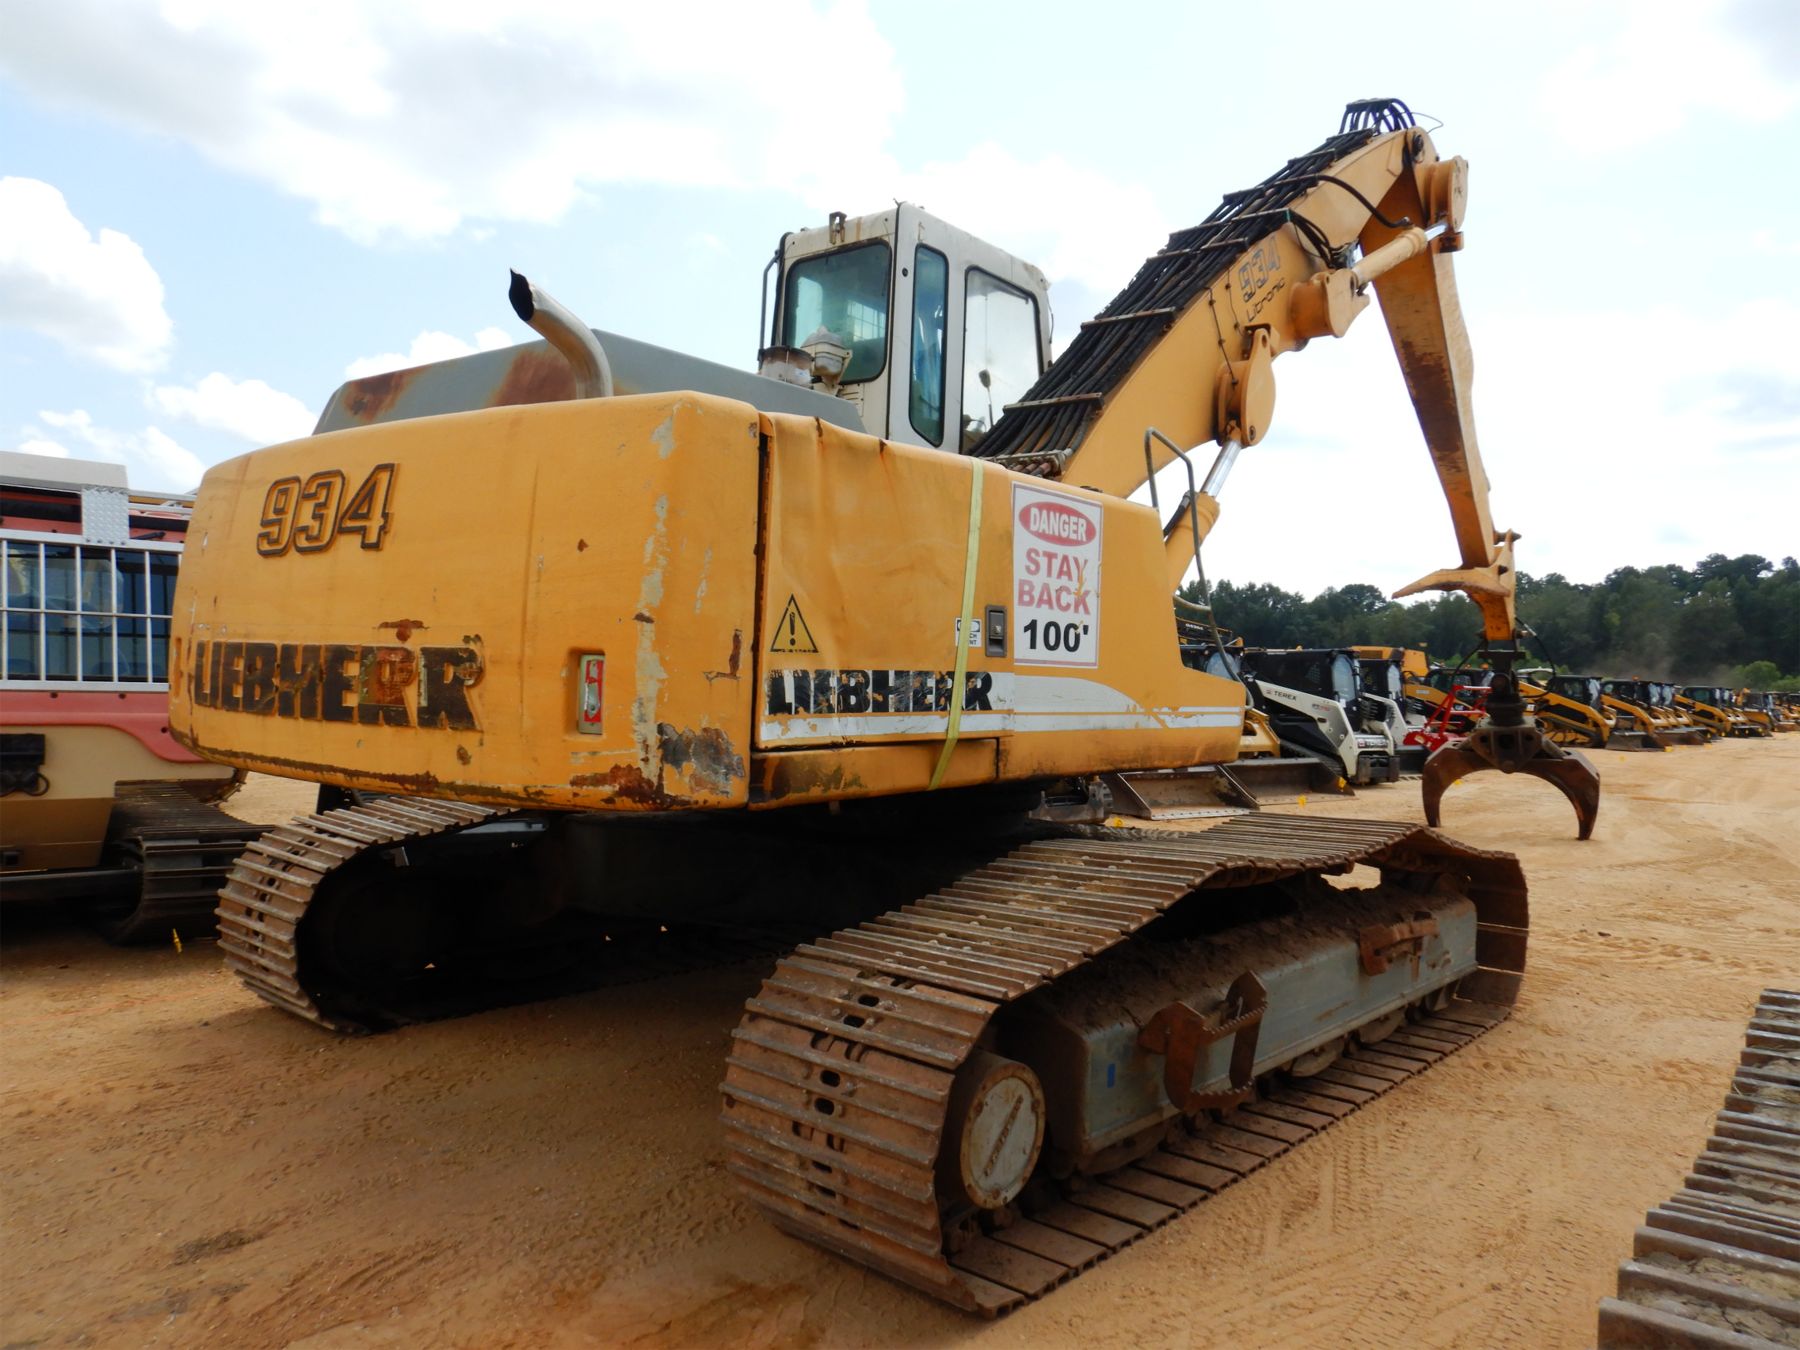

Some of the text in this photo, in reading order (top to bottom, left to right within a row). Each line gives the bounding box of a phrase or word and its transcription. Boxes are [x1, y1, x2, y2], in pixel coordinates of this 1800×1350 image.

[256, 462, 397, 557] 934
[1029, 506, 1087, 543] DANGER
[1024, 547, 1089, 583] STAY
[1017, 578, 1091, 615] BACK
[1023, 618, 1090, 653] 100'
[194, 638, 483, 733] LIEBHERR
[768, 668, 993, 716] LIEBHERR
[1274, 690, 1297, 701] TEREX
